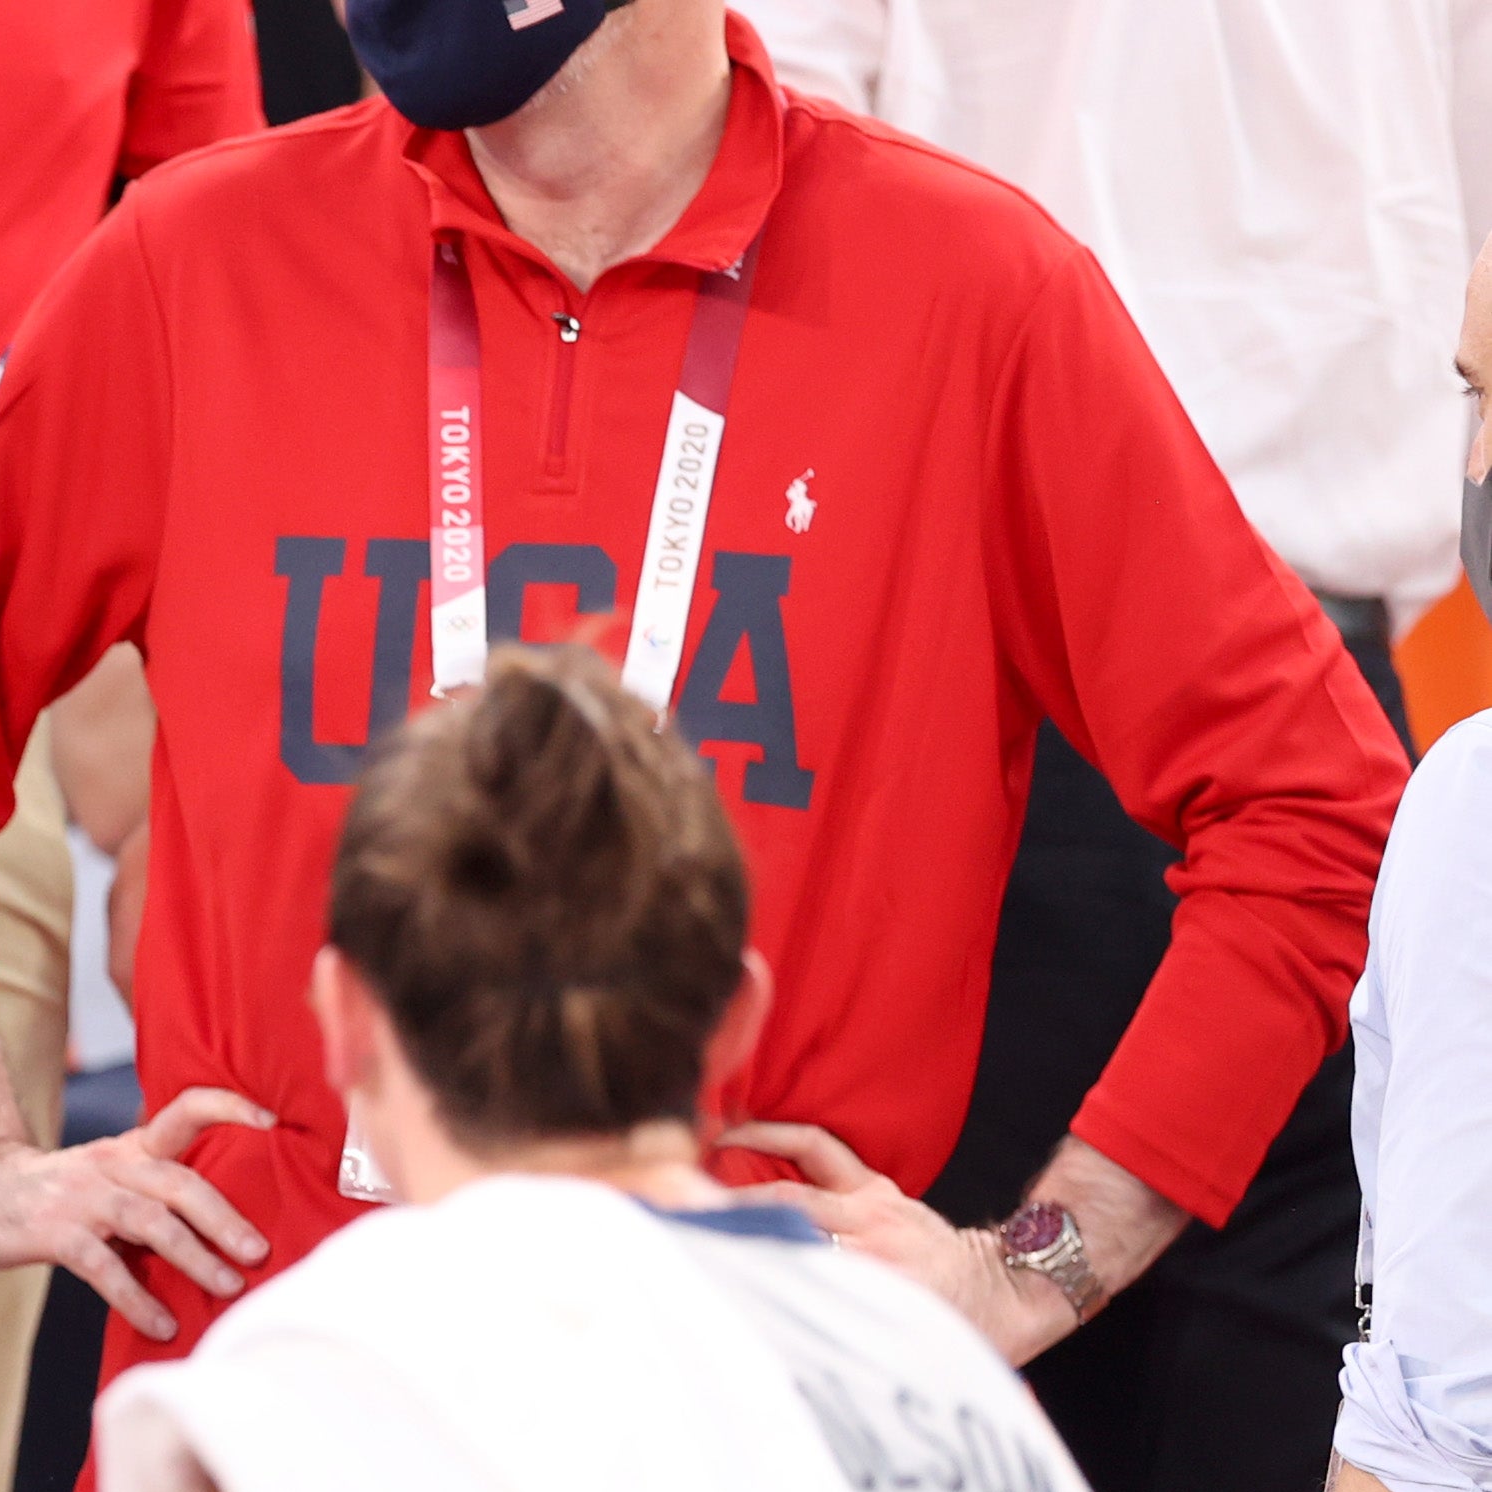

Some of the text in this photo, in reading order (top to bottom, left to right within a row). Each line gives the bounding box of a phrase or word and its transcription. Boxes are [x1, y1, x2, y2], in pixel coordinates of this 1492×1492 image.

[439, 406, 472, 583] TOKYO 2020
[654, 421, 709, 592] TOKYO 2020
